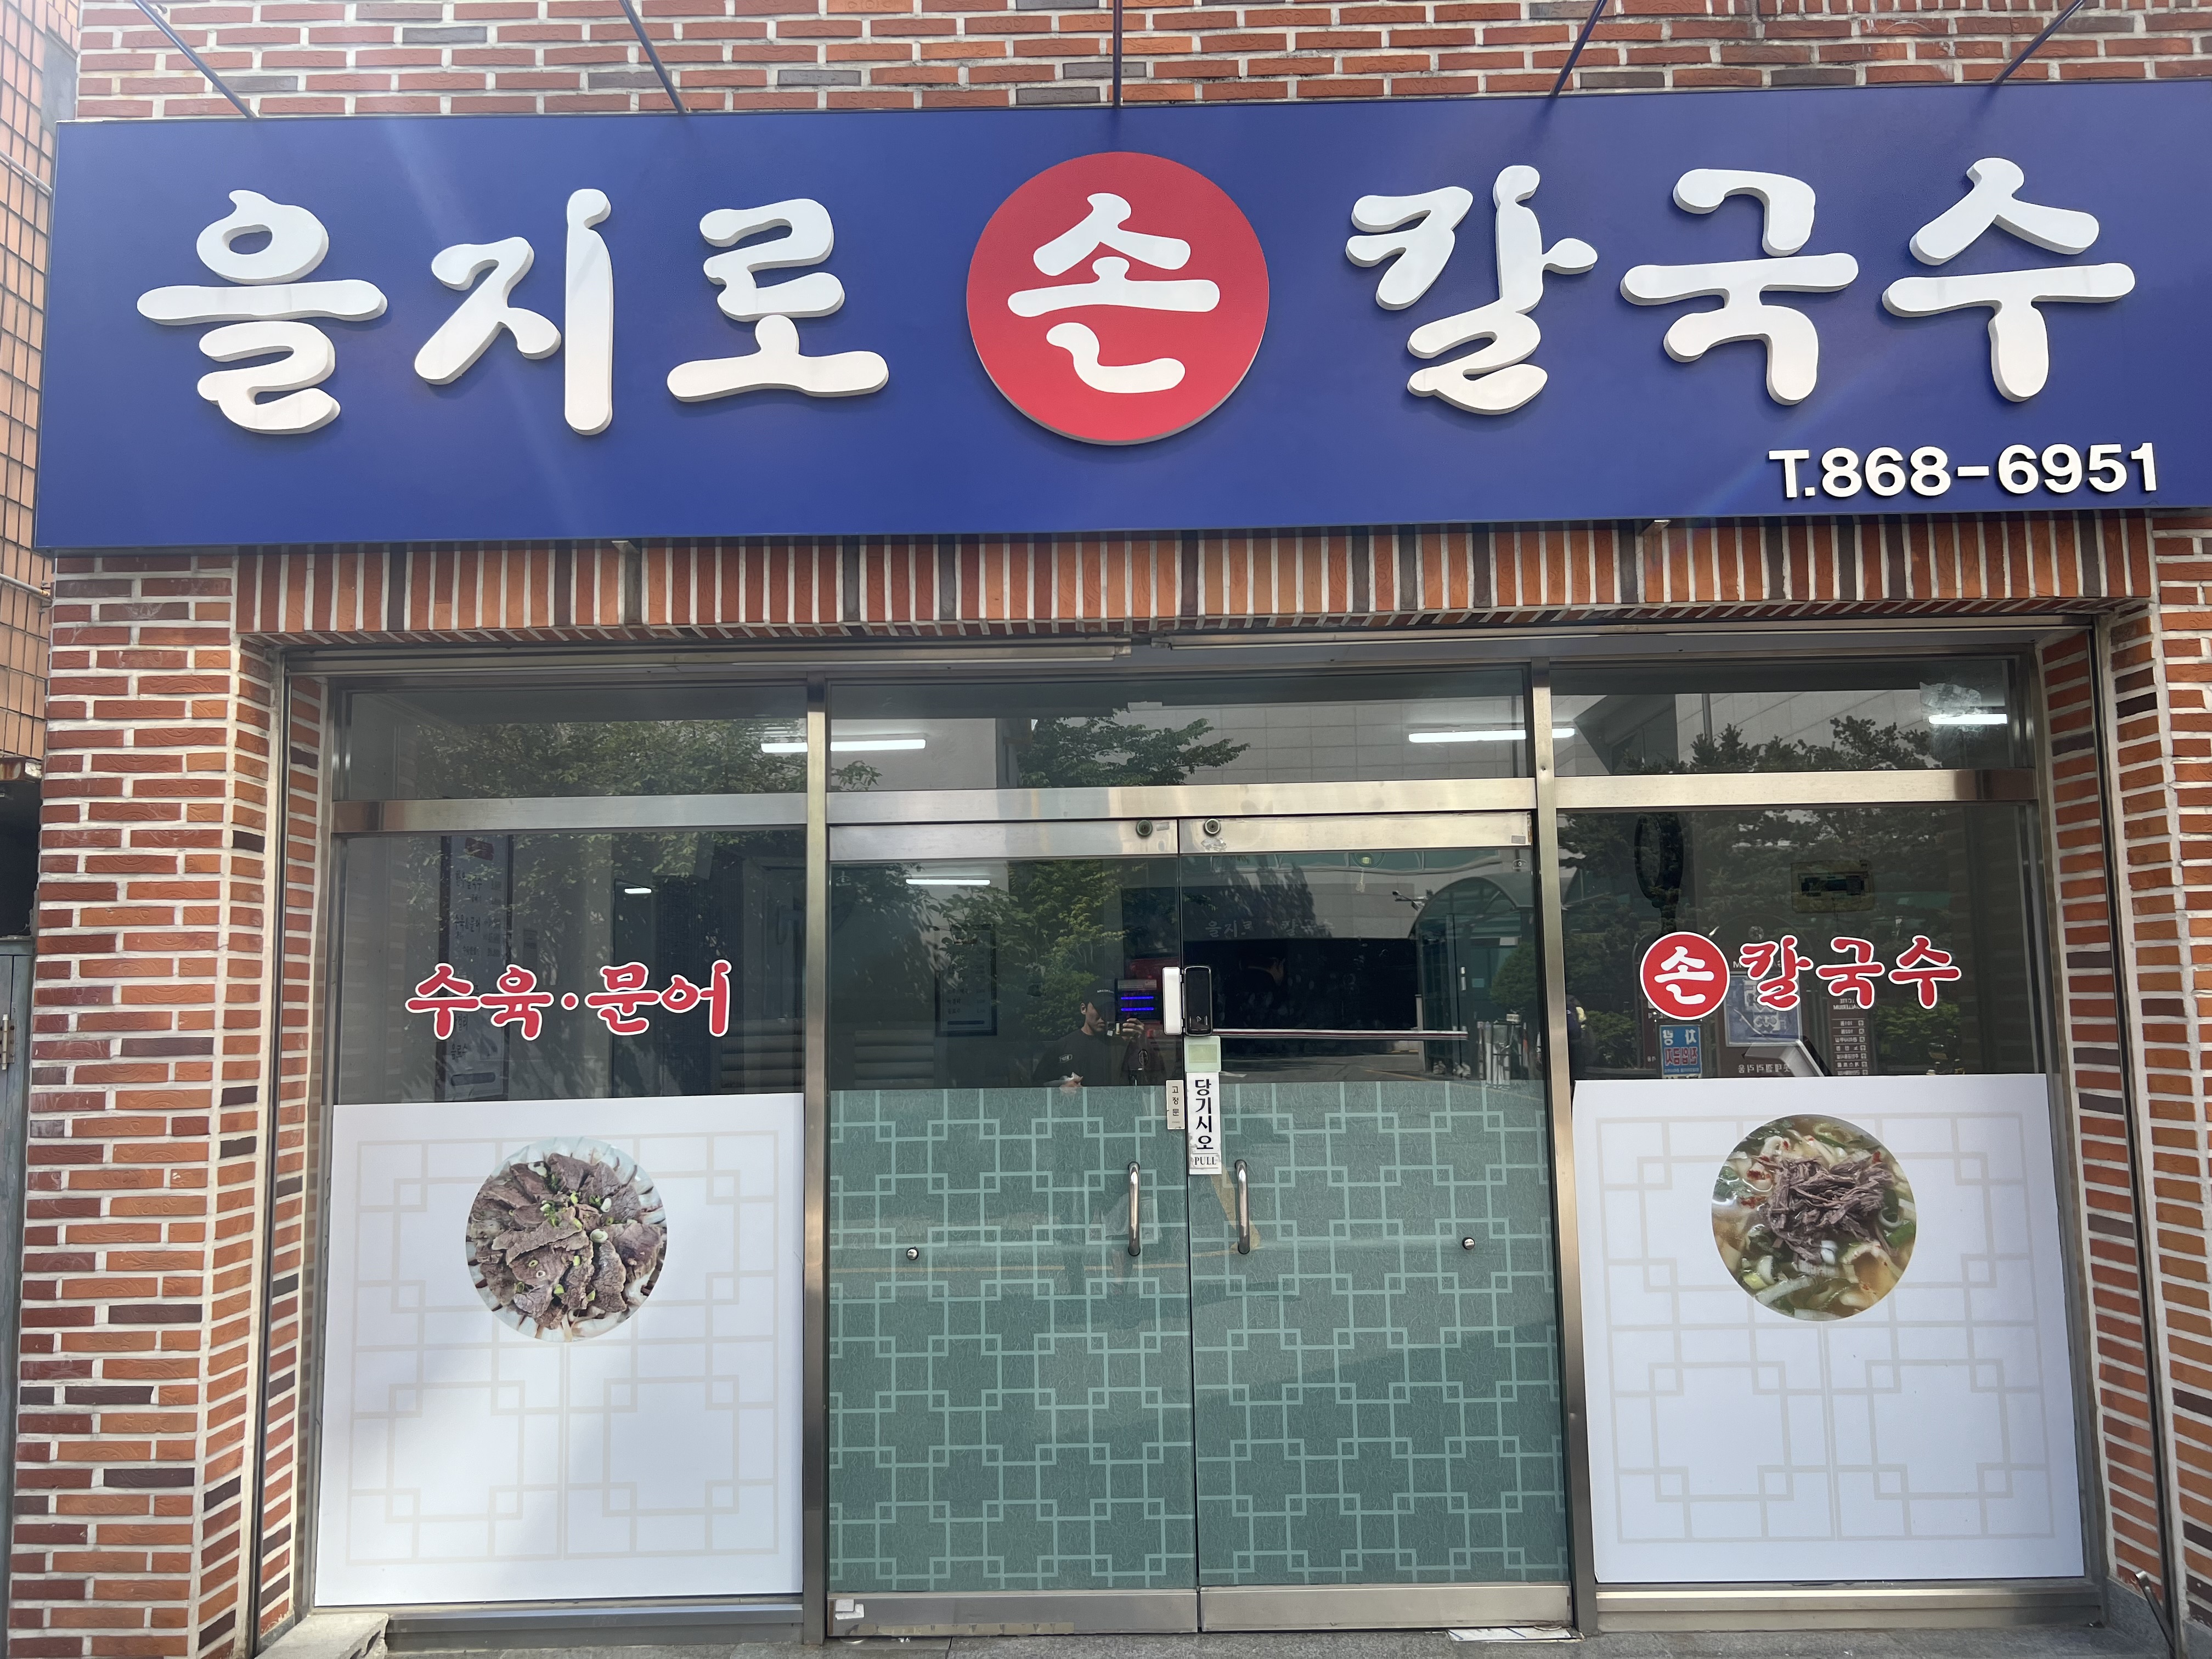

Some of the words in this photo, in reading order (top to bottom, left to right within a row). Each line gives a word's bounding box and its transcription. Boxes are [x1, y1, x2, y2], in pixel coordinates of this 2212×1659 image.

[137, 189, 889, 435] 을지로
[1008, 193, 1220, 393] 손
[1345, 157, 2135, 415] 칼국수
[1769, 442, 2158, 500] T.868-6951
[1739, 934, 1961, 1011] 칼국수
[1195, 1079, 1214, 1150] 당기시오
[1194, 1156, 1216, 1166] PULL
